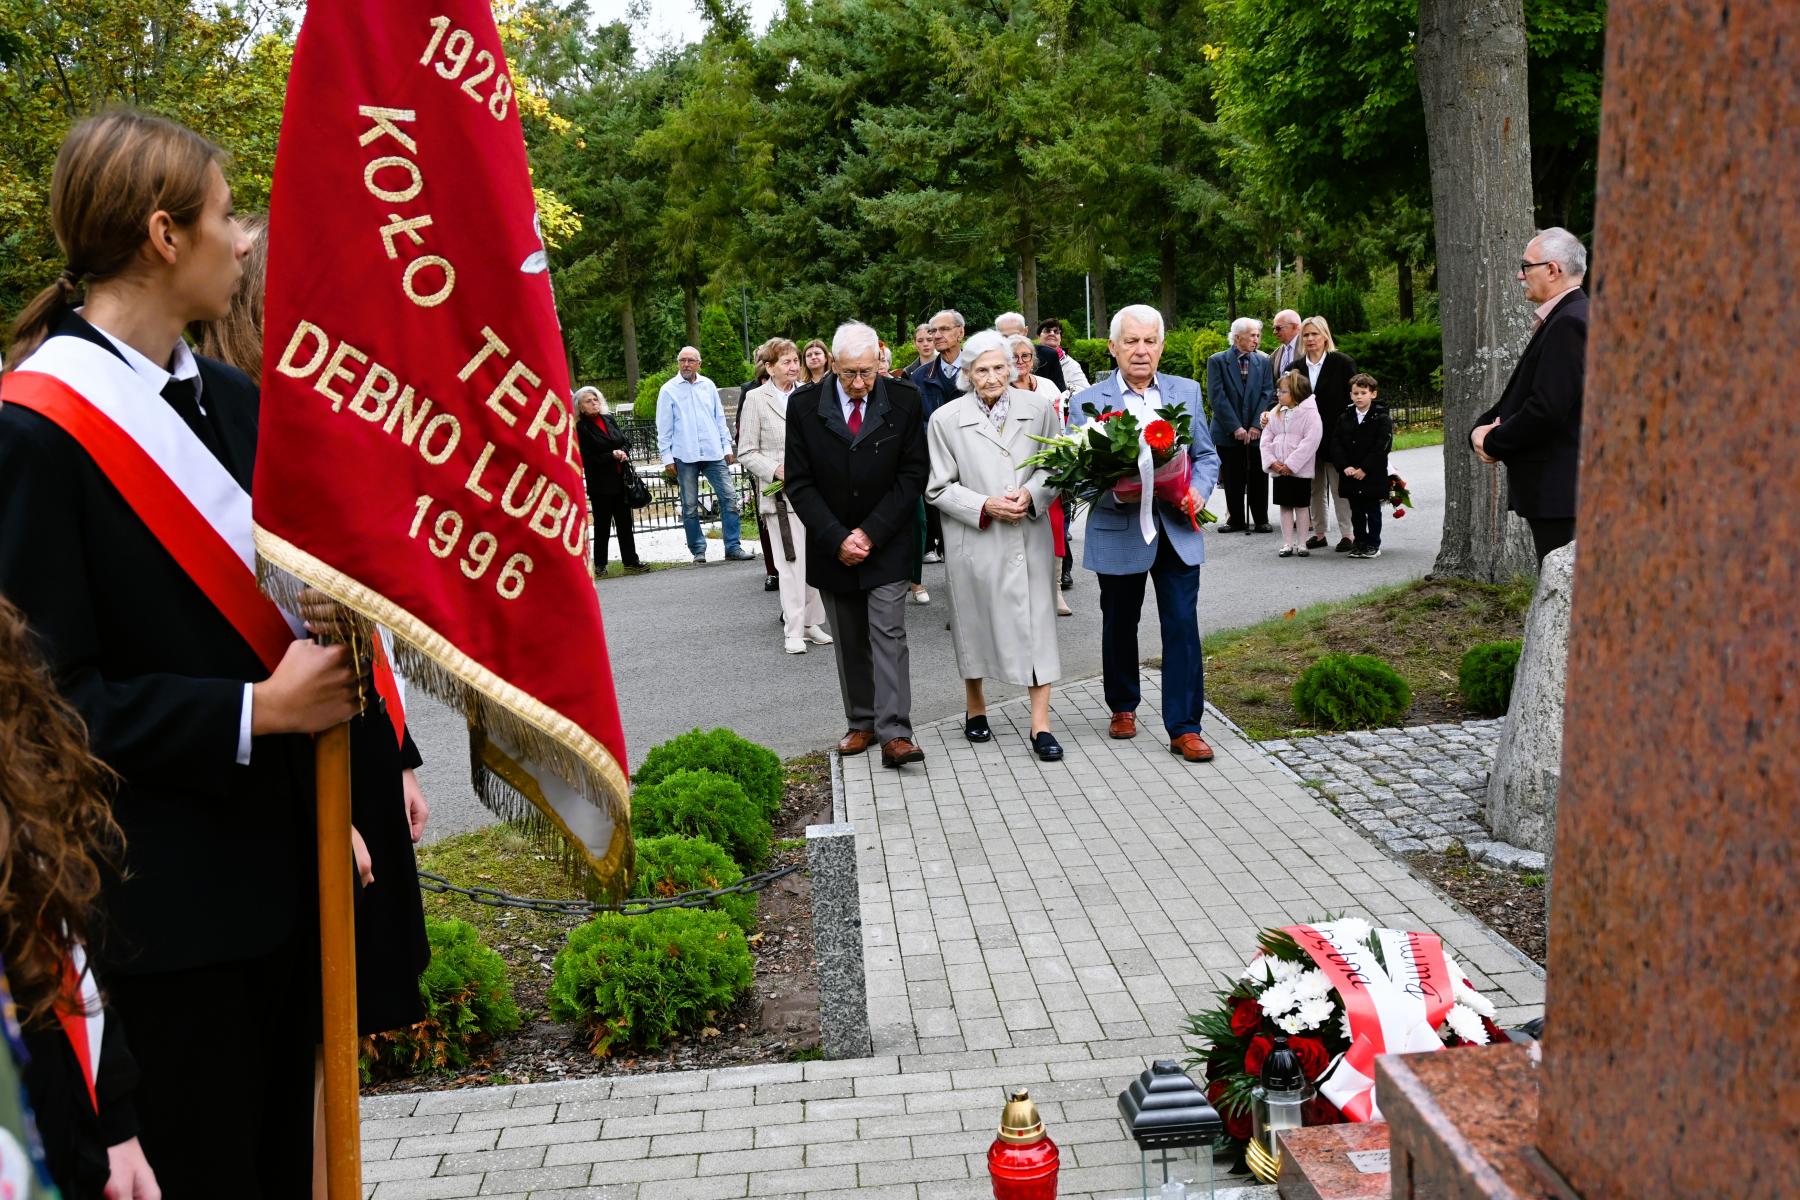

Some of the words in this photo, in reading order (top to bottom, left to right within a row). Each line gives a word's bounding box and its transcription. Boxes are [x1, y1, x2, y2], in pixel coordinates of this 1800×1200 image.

[419, 15, 513, 121] 1928
[358, 104, 456, 307] KOŁO
[276, 319, 462, 465] DĘBNO
[464, 441, 590, 560] LUBU
[408, 494, 534, 600] 1996
